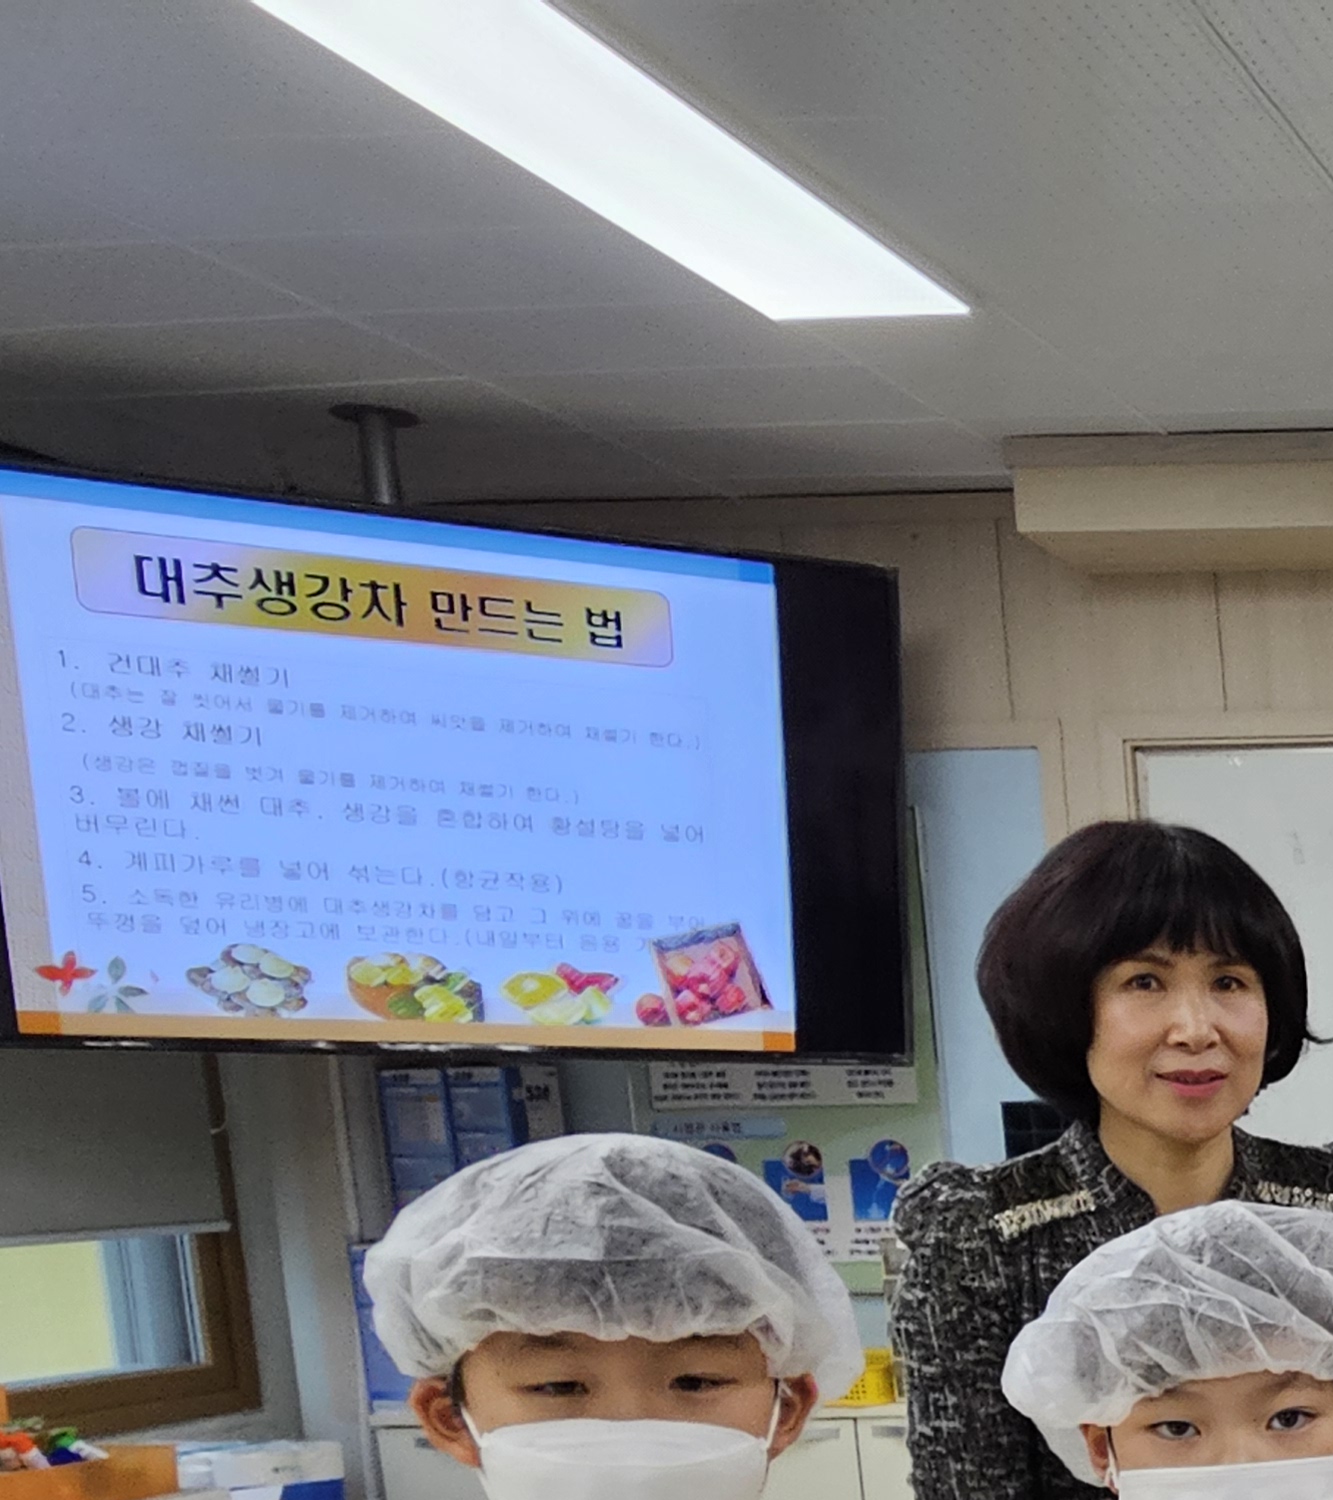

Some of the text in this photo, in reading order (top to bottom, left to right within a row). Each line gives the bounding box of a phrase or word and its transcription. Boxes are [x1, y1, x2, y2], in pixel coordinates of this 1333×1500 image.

[133, 554, 623, 649] 대추생강차 만드는 법
[57, 650, 290, 688] 1. 건대추 채썰기
[61, 712, 262, 747] 2. 생강 채썰기
[69, 785, 94, 806] 3.
[343, 802, 417, 827] 생강을
[75, 812, 199, 841] 버무린다.
[78, 849, 102, 870] 4.
[81, 884, 107, 905] 5.
[128, 888, 198, 909] 소독한
